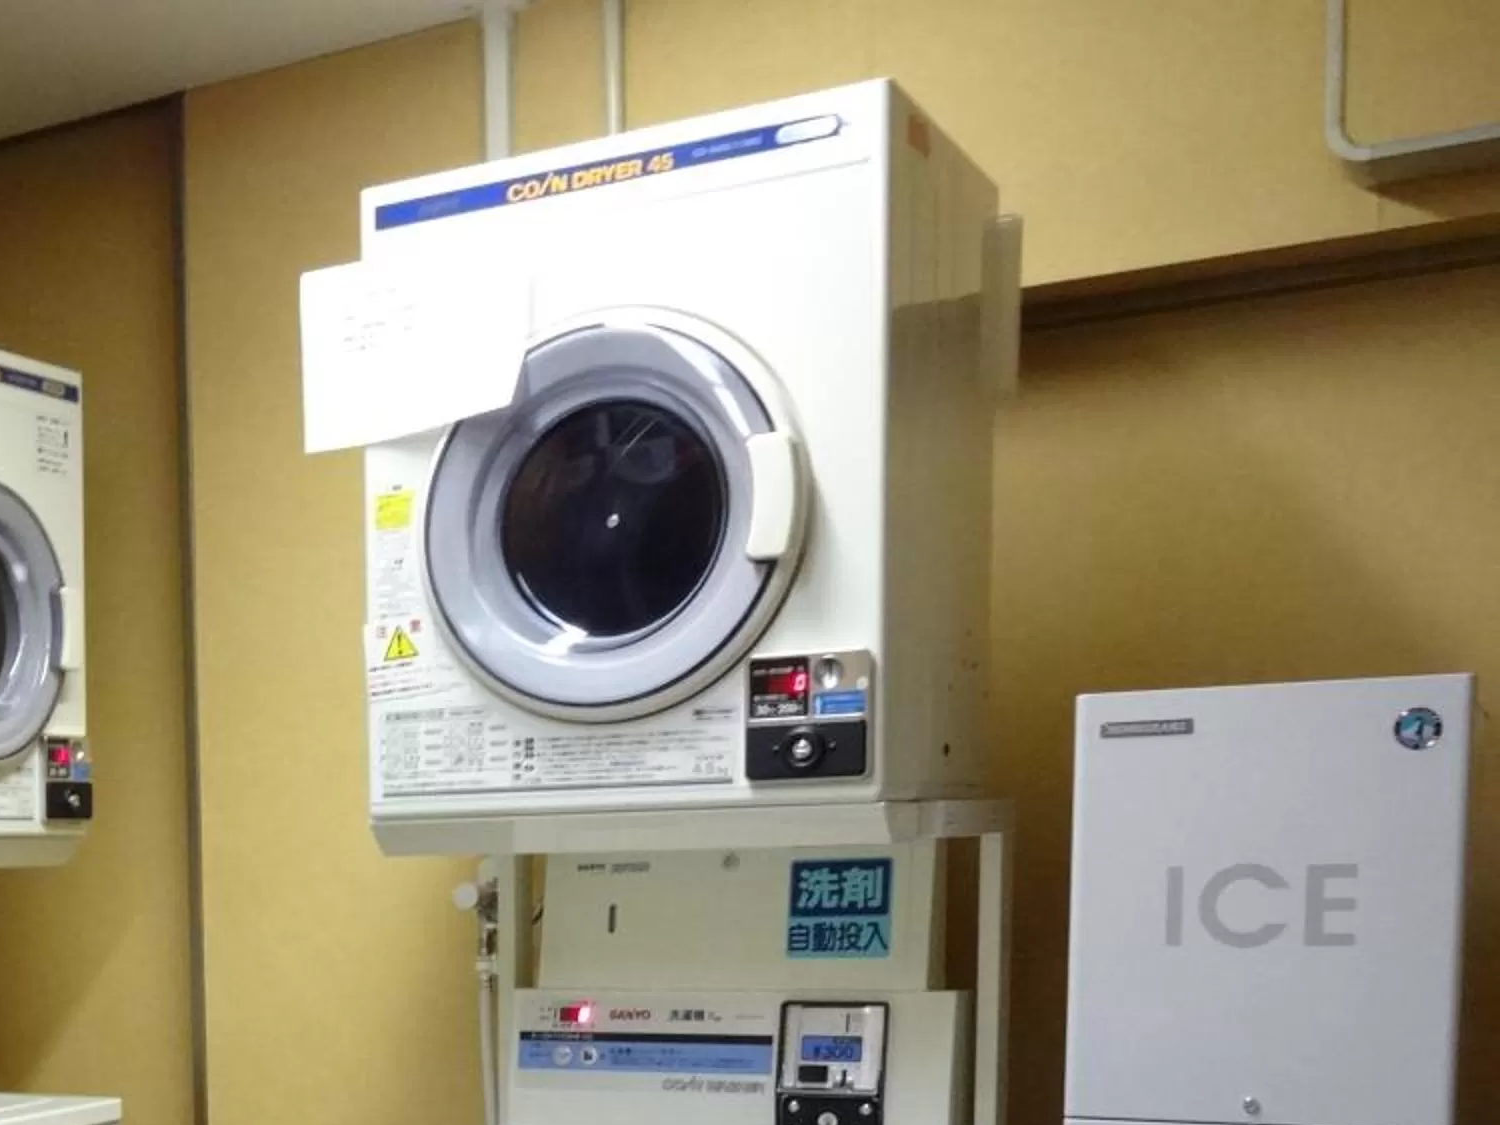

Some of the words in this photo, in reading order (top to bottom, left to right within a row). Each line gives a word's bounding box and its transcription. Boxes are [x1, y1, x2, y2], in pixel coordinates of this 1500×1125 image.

[571, 158, 643, 189] DRYER
[647, 151, 674, 173] 45
[797, 866, 883, 910] 洗剤
[1164, 863, 1358, 949] ICE
[788, 922, 888, 952] 自動投入
